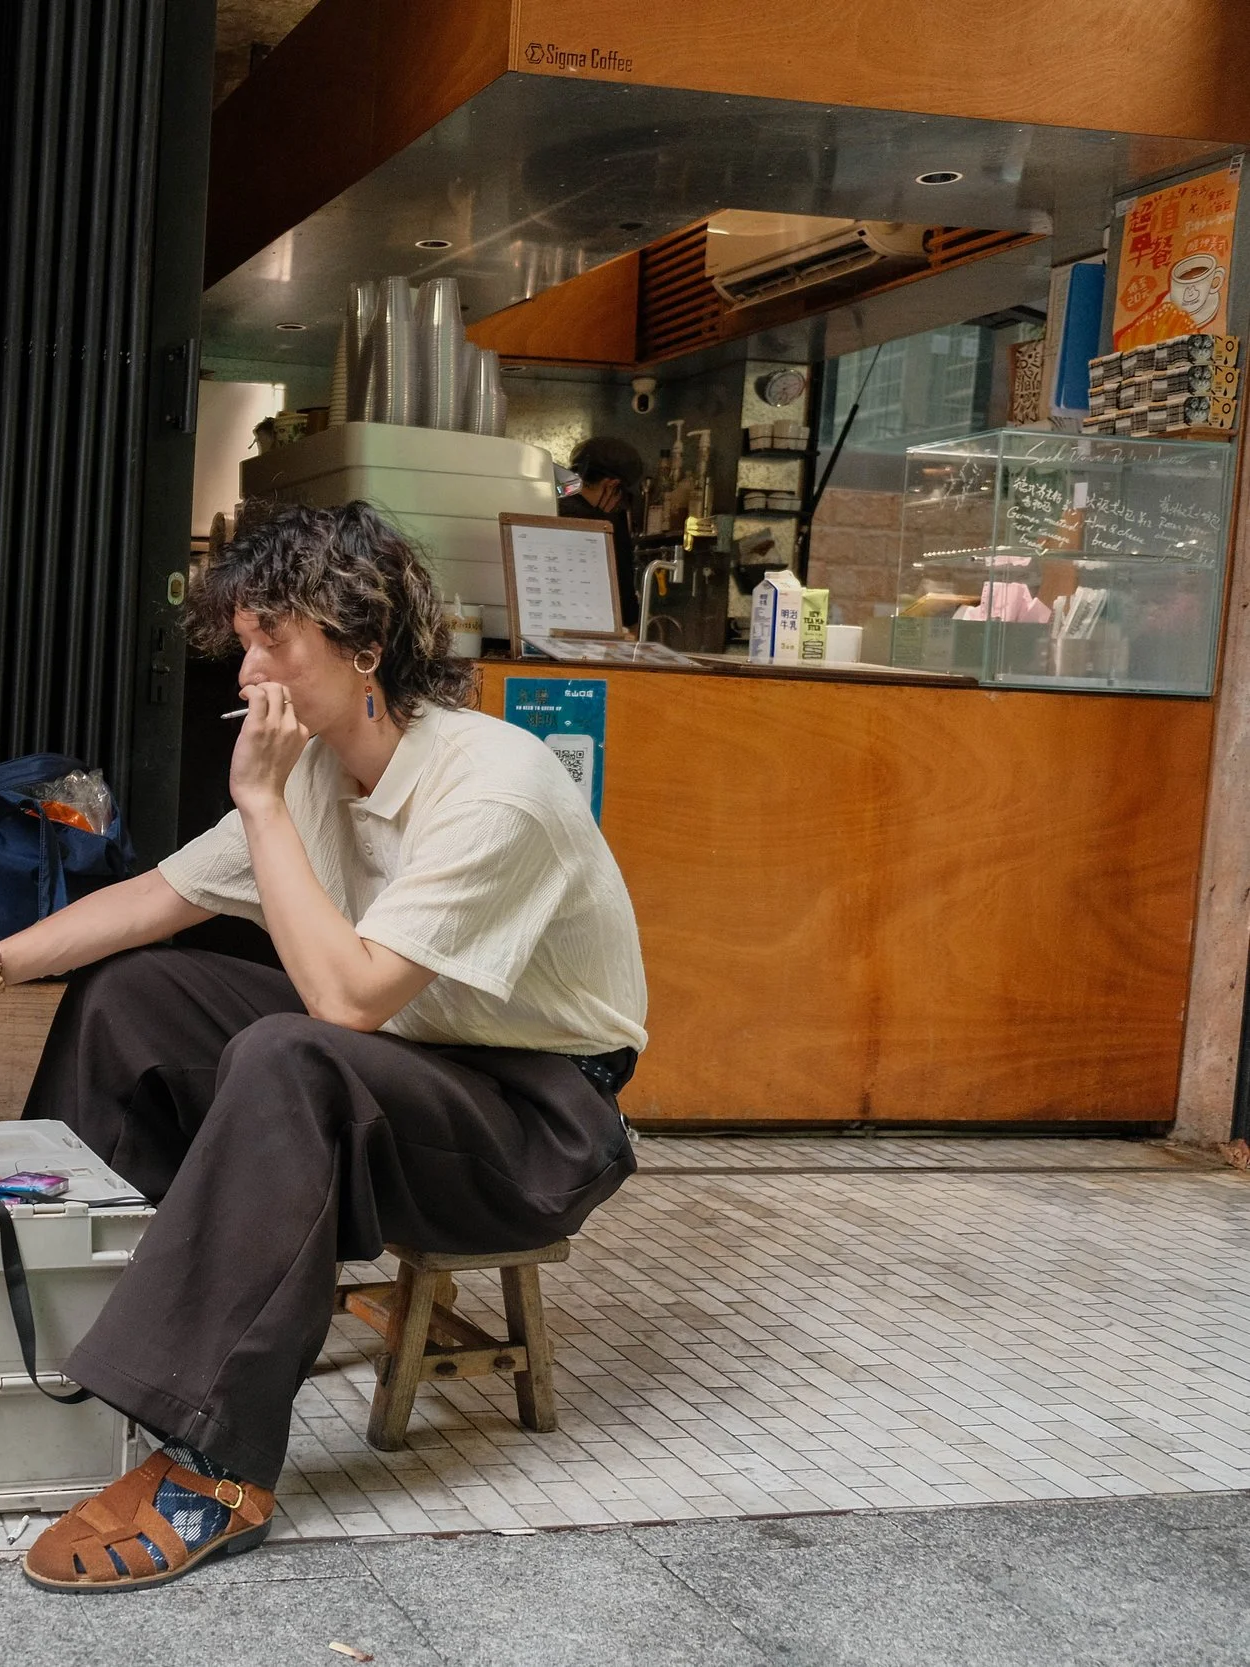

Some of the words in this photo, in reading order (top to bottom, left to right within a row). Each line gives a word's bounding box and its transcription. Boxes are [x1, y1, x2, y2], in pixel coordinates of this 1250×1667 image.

[546, 43, 587, 69] Sigma
[591, 48, 633, 72] Coffee
[1091, 533, 1123, 552] bread
[781, 609, 798, 620] 明治
[780, 620, 797, 631] 牛乳
